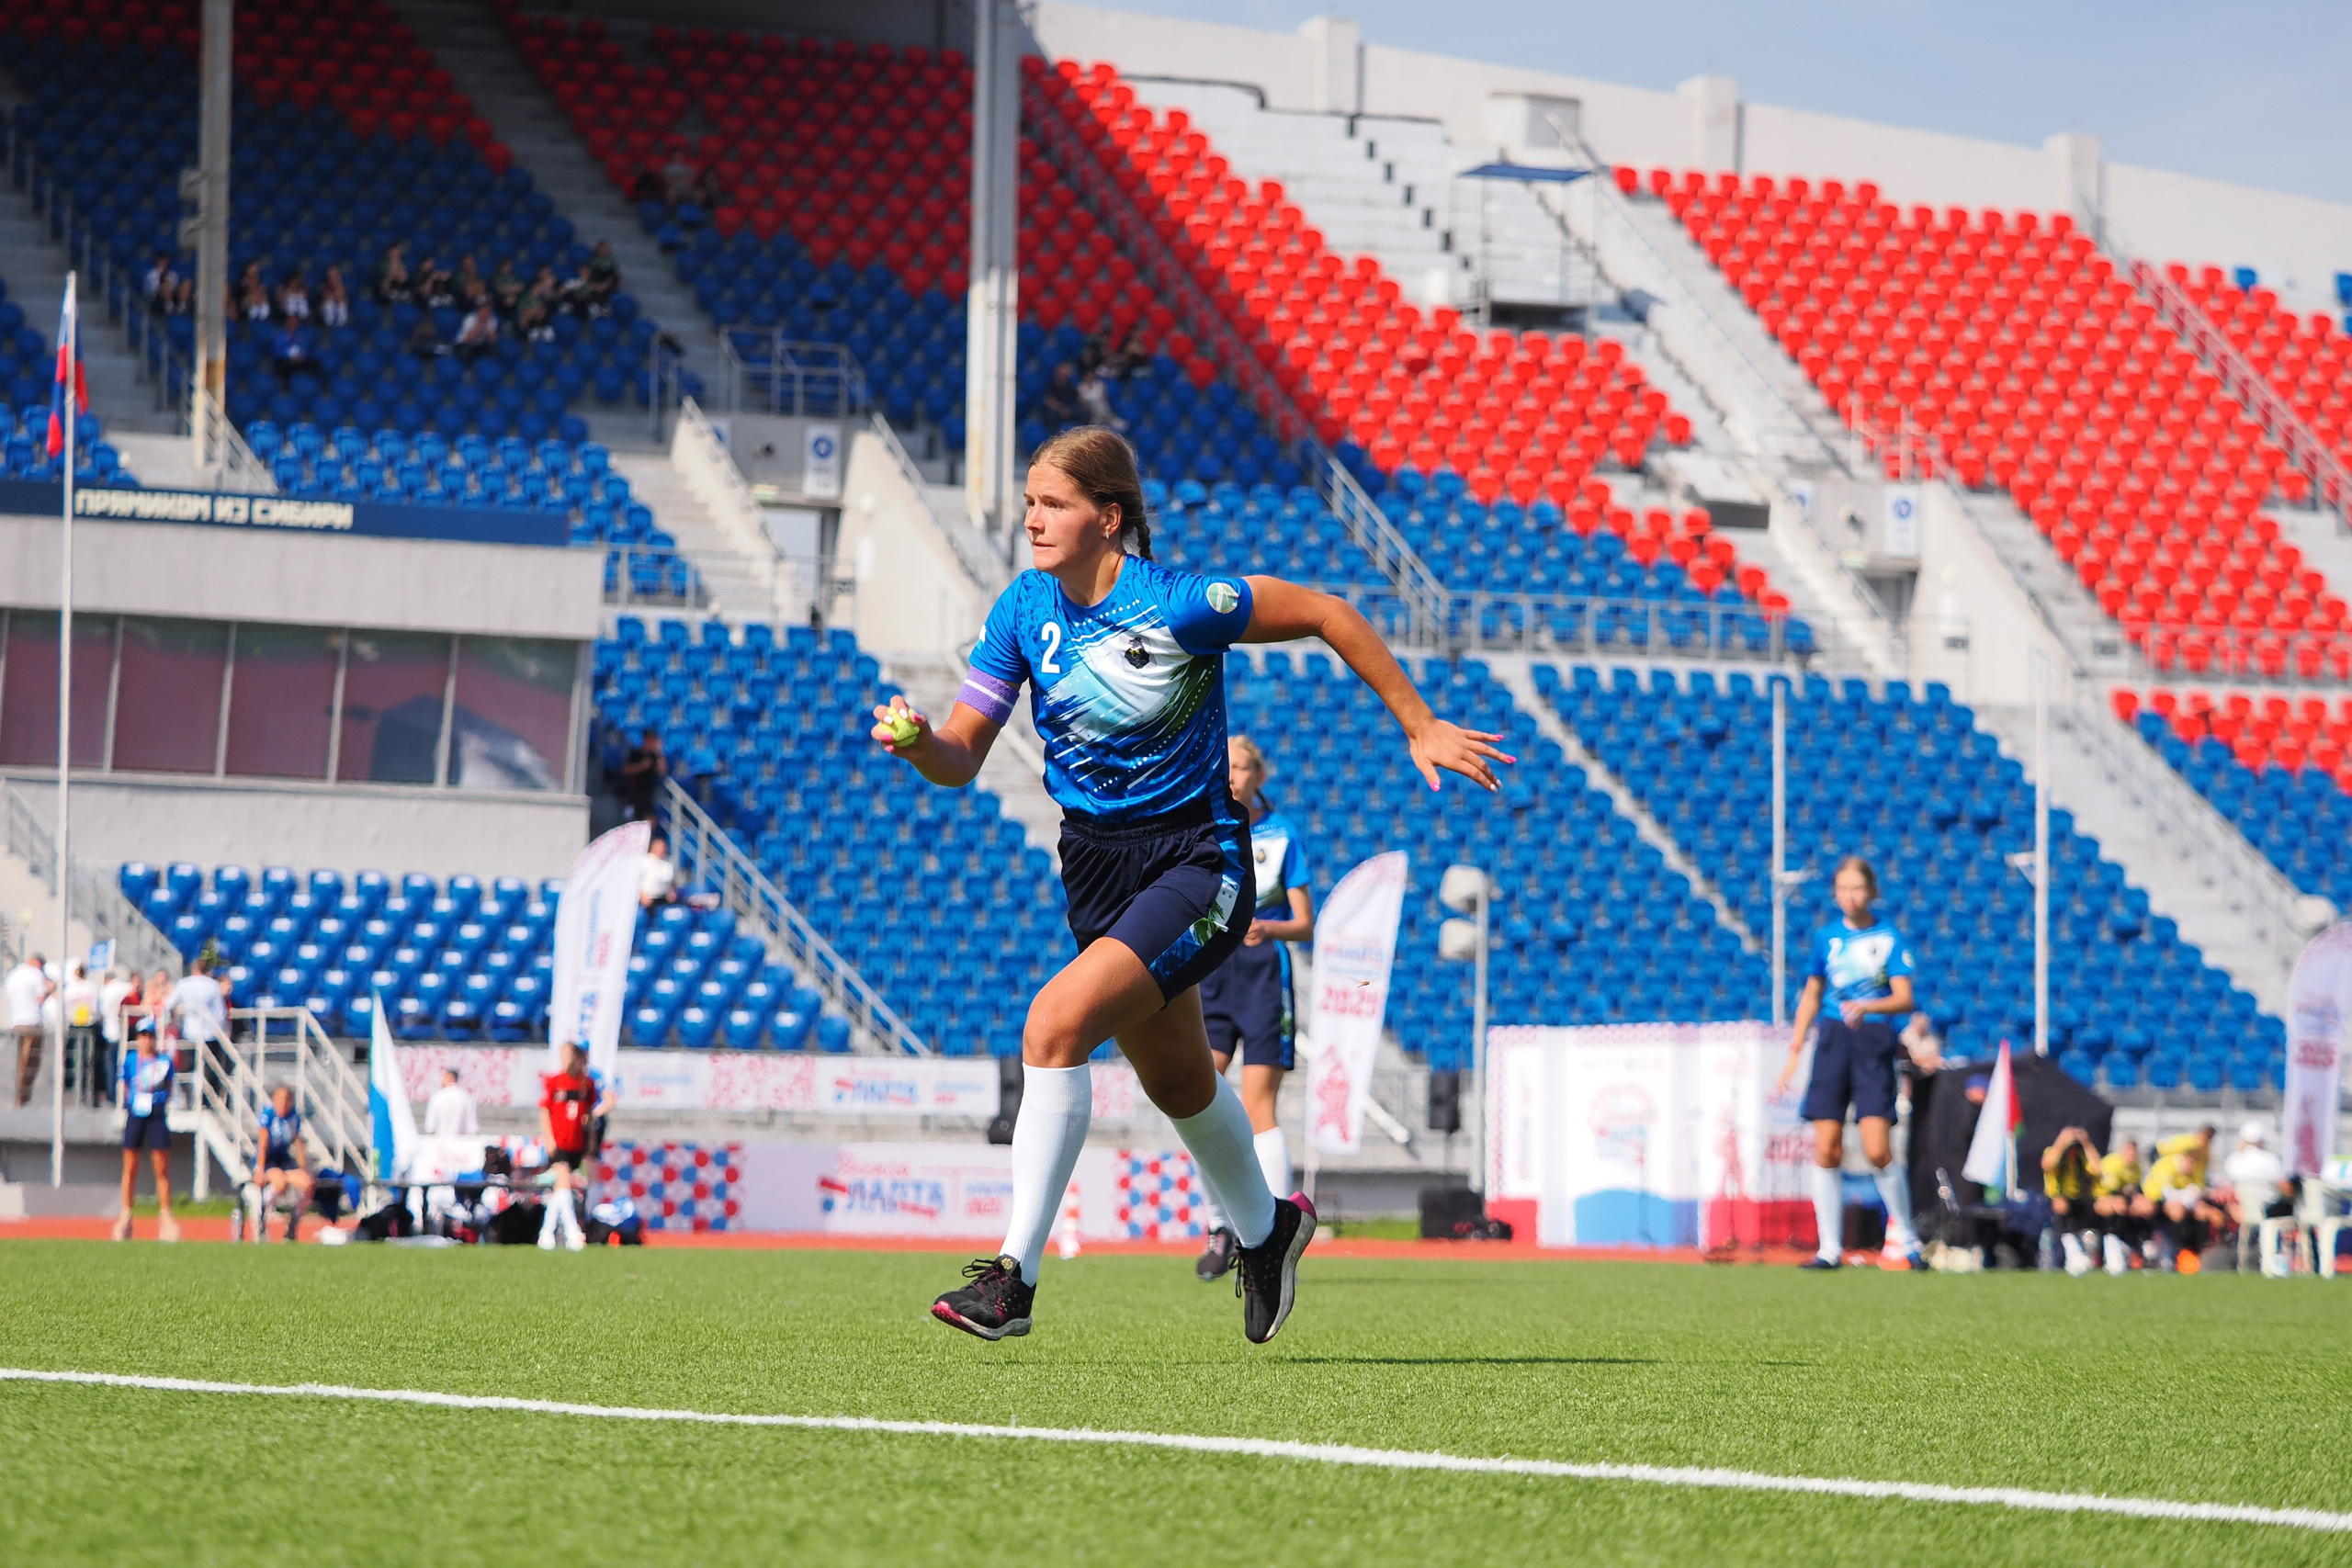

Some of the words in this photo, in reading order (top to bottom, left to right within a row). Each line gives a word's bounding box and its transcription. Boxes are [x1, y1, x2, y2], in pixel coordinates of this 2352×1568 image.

[74, 488, 212, 522] ПРЯМИКОМ
[213, 495, 250, 525] ИЗ
[252, 498, 354, 530] СИБИРИ
[1041, 621, 1061, 674] 2
[846, 1179, 944, 1213] ЛАПТА
